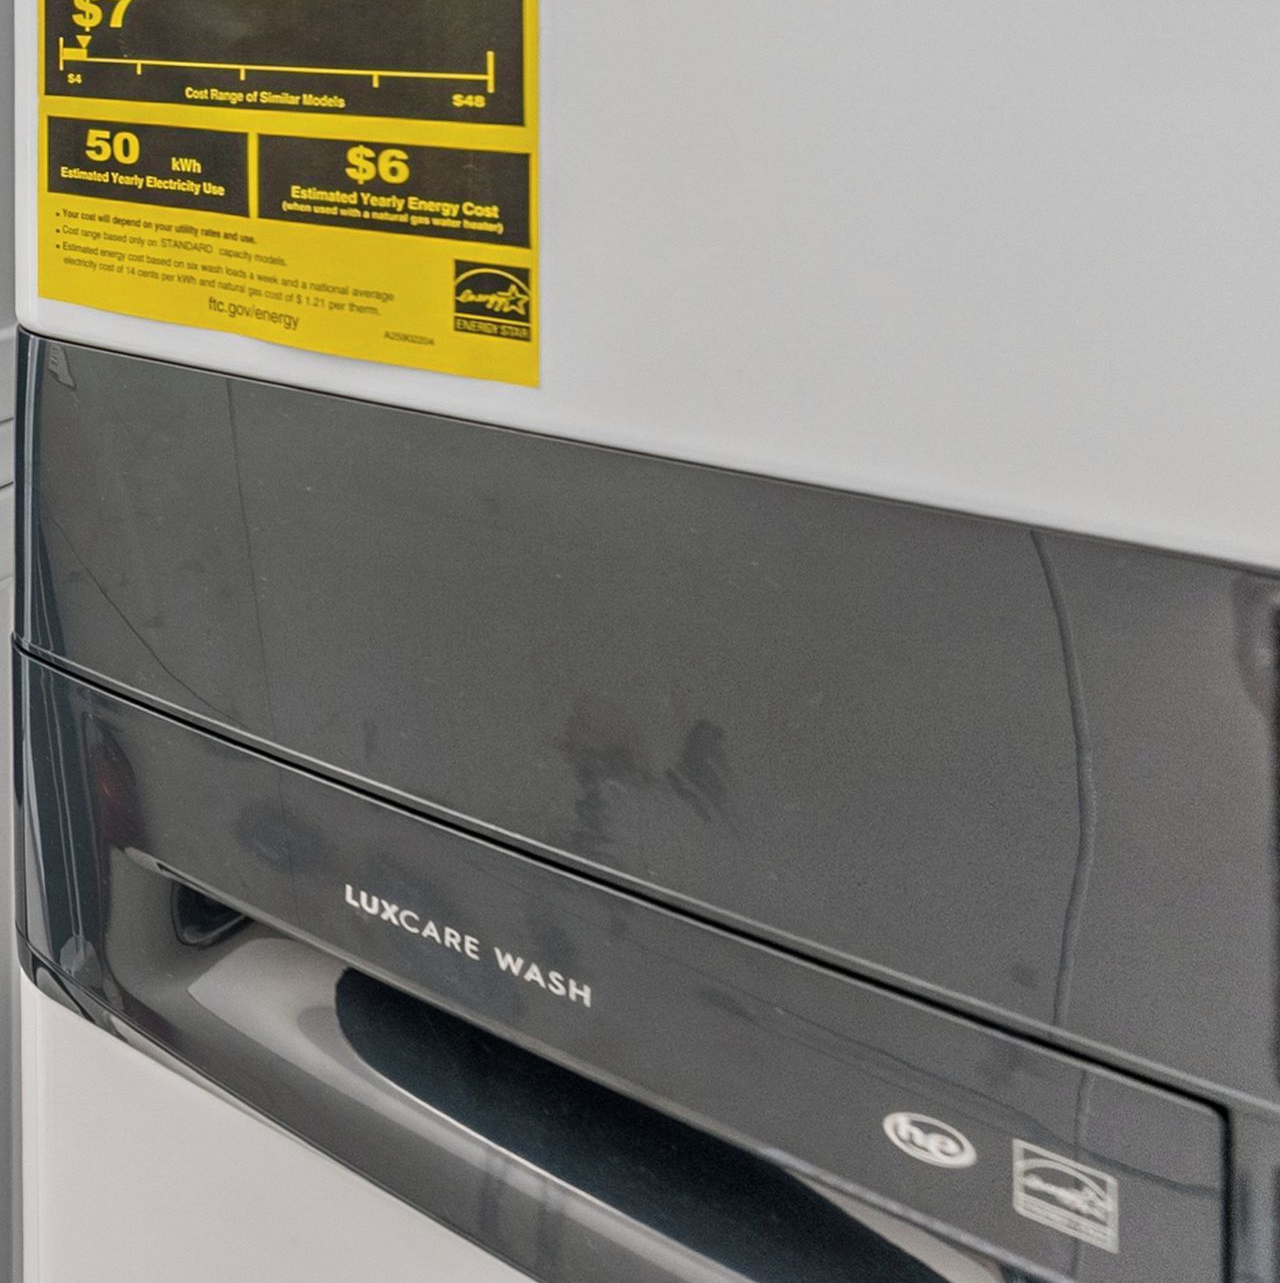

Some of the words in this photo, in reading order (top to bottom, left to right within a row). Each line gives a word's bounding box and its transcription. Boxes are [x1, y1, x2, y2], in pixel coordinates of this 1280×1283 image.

[67, 73, 83, 84] $4
[184, 87, 209, 100] Cost
[210, 89, 244, 104] Range
[246, 90, 258, 102] of
[260, 91, 300, 106] Similar
[302, 94, 346, 109] Models
[85, 128, 141, 164] 50
[171, 157, 202, 174] kWh
[345, 144, 410, 185] $6
[60, 166, 110, 183] Estimated
[111, 172, 144, 188] Yearly
[146, 176, 201, 196] Electricity
[202, 182, 225, 196] Use
[291, 185, 358, 205] Estimated
[360, 192, 405, 212] Yearly
[408, 196, 460, 217] Energy
[462, 202, 500, 219] Cost
[208, 296, 300, 330] ftc.gov/energy
[345, 884, 480, 960] LUXCARE
[494, 946, 591, 1008] WASH
